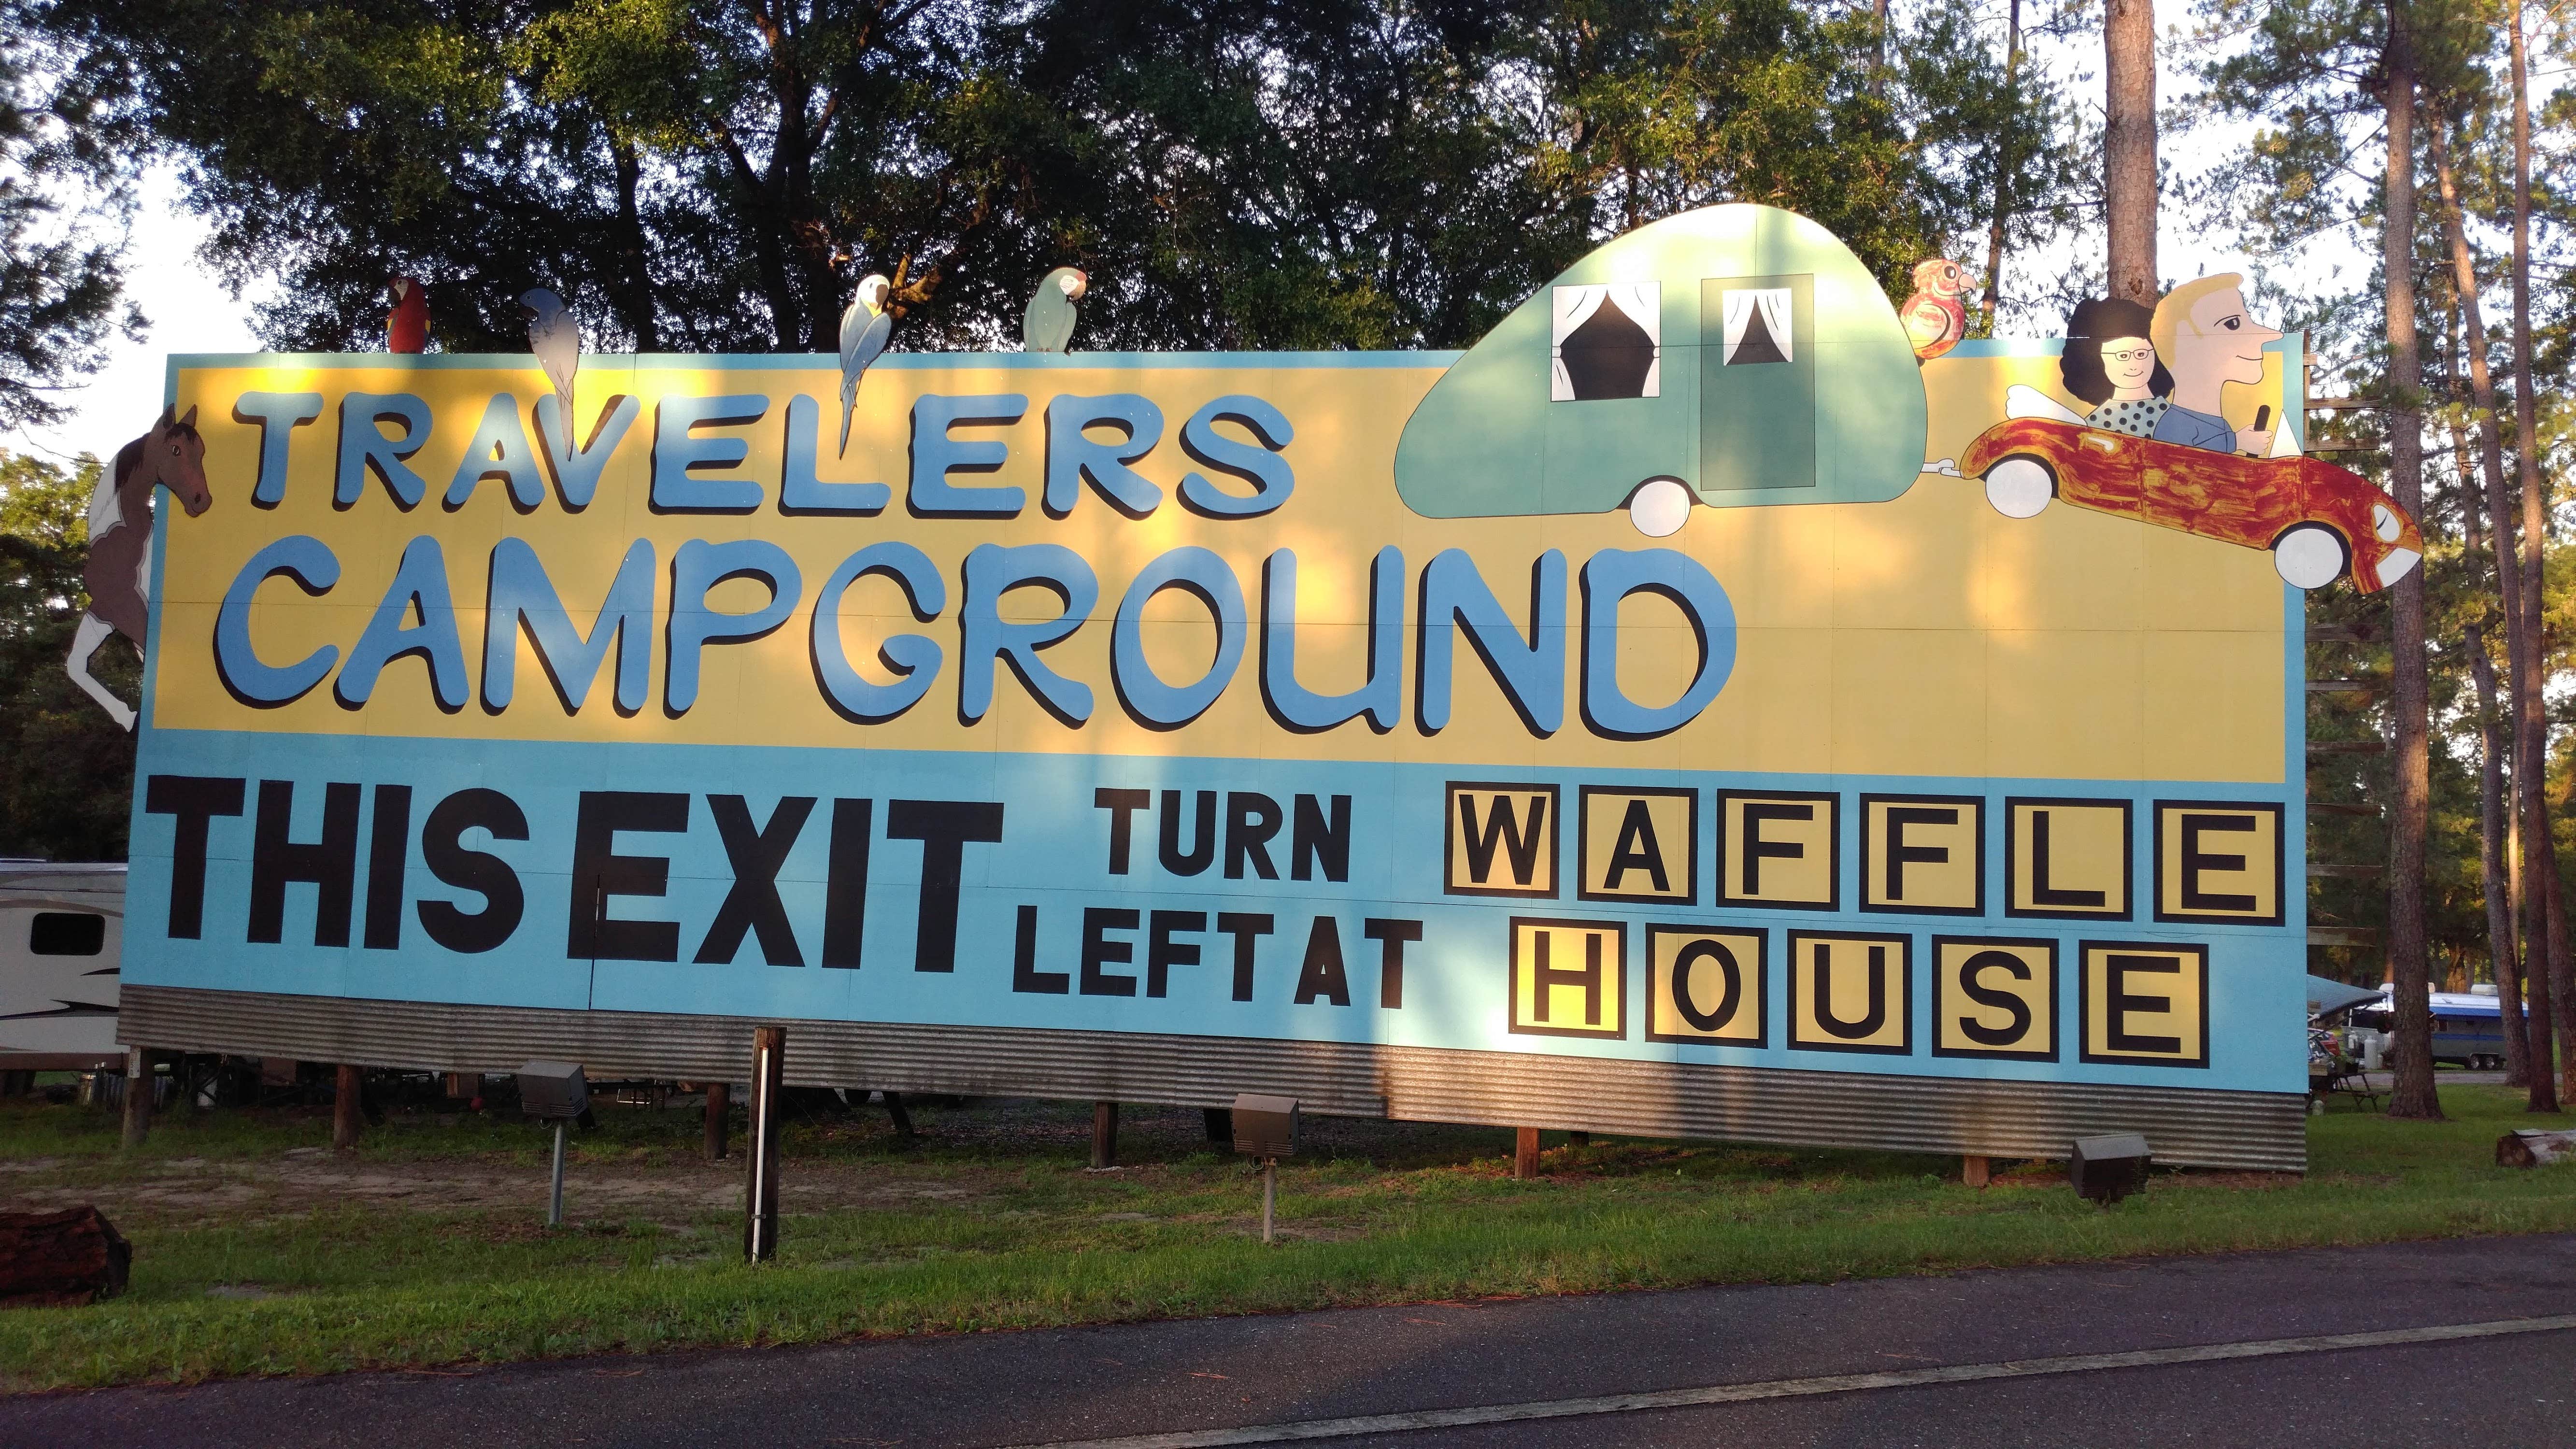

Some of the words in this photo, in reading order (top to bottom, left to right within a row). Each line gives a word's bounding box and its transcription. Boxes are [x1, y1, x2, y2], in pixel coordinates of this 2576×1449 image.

[232, 391, 1295, 519] TRAVELERS
[213, 534, 1737, 741] CAMPGROUND
[146, 775, 529, 953] THIS
[568, 791, 1004, 972] EXIT
[1095, 788, 1352, 882] TURN
[1459, 795, 2257, 911] WAFFLE
[1013, 906, 1274, 1001] LEFT
[1294, 916, 1423, 1009] AT
[1534, 930, 2181, 1053] HOUSE
